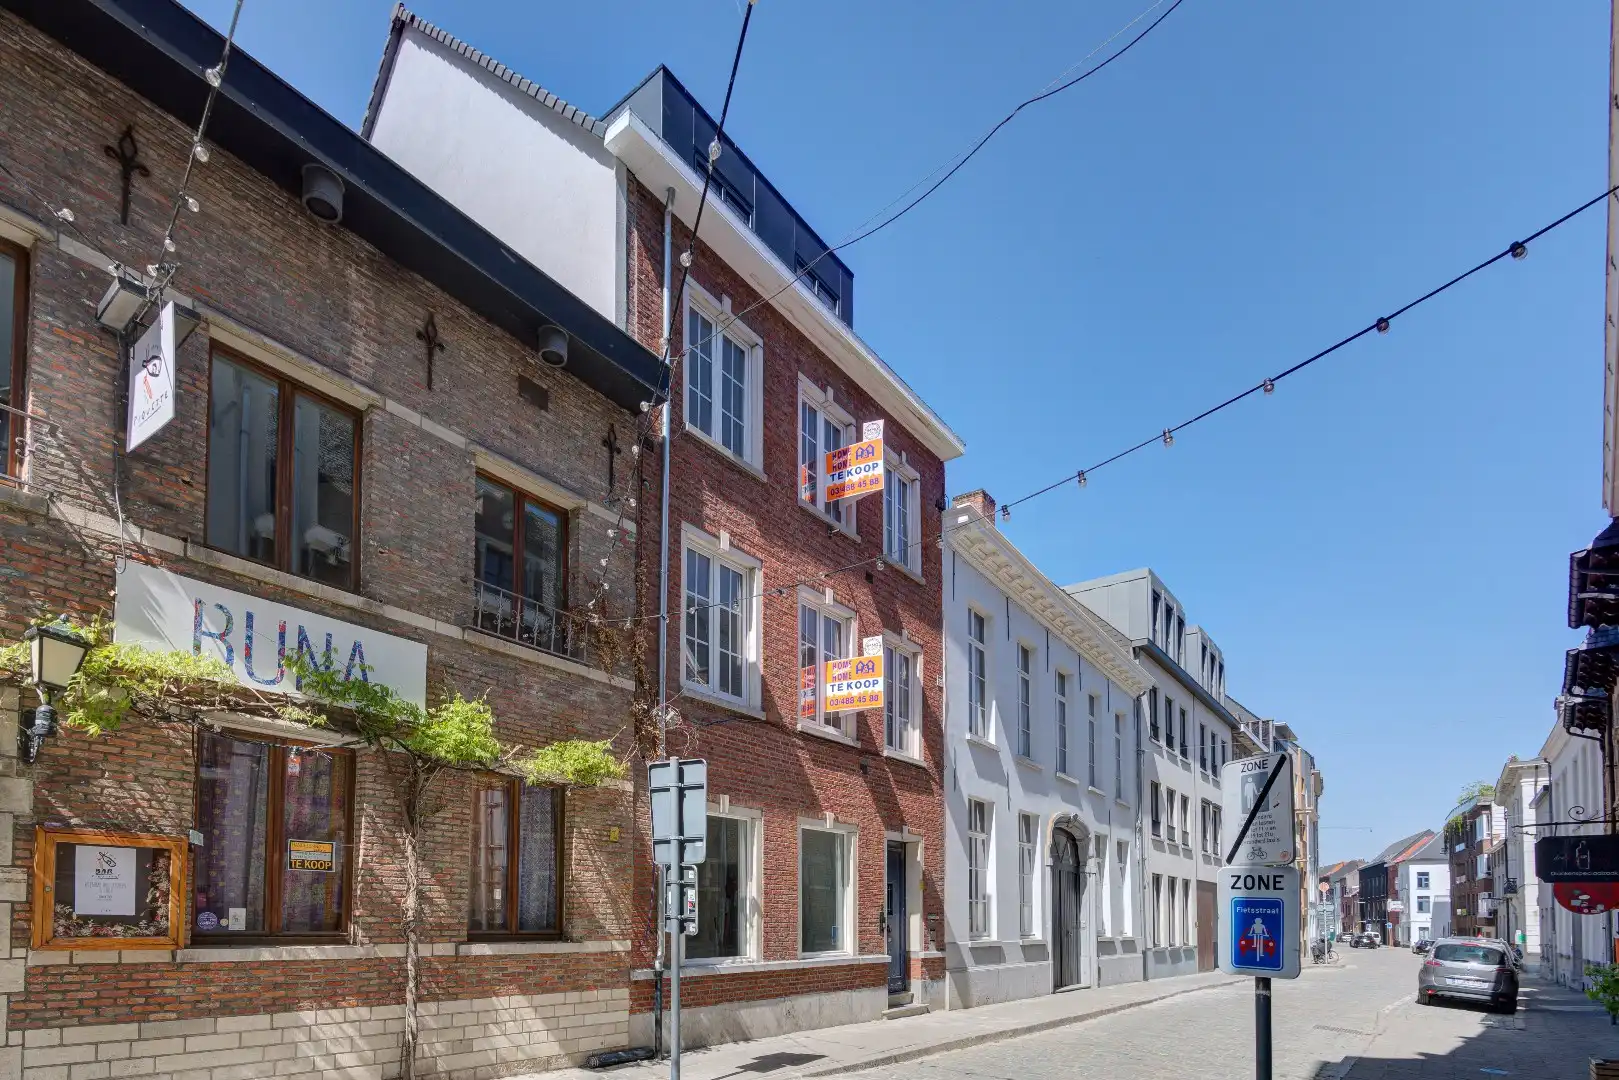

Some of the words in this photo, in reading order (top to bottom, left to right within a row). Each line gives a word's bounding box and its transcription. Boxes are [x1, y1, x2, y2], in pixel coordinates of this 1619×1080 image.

[830, 471, 844, 482] TE
[847, 462, 879, 478] KOOP
[830, 682, 844, 692] TE
[846, 679, 879, 691] KOOP
[1240, 758, 1269, 773] ZONE
[290, 859, 303, 869] TE
[304, 859, 332, 870] KOOP
[1230, 874, 1285, 891] ZONE
[1236, 906, 1280, 915] Fietsstraat
